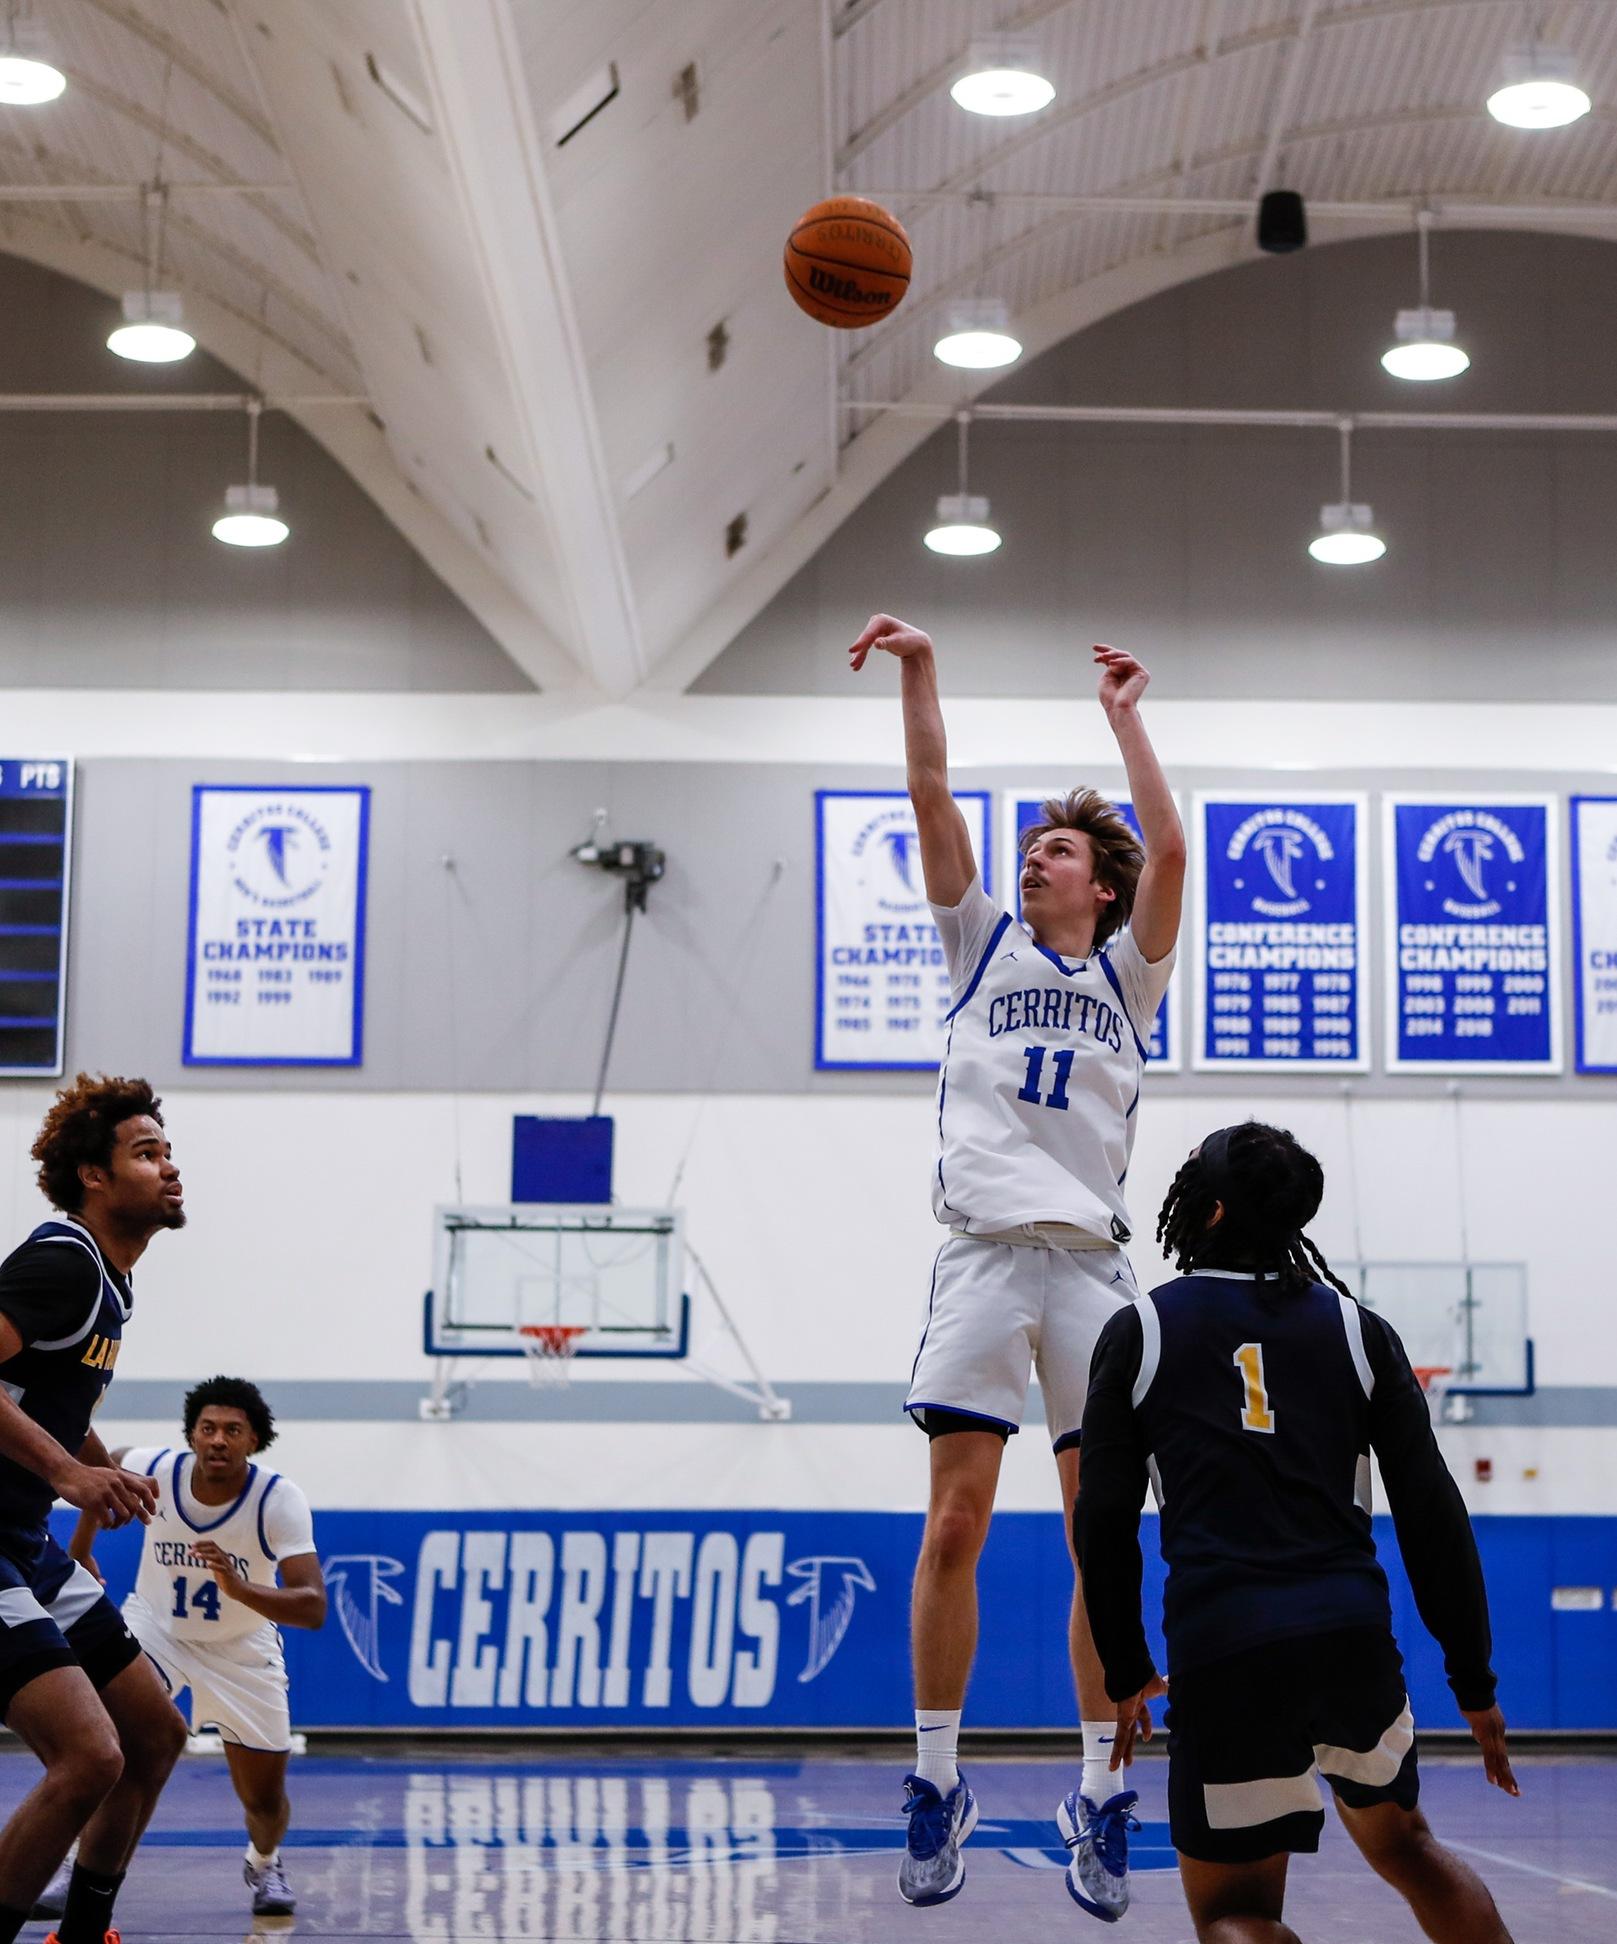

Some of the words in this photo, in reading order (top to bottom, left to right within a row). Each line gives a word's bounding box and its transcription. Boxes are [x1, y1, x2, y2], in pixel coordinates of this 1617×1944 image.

[808, 265, 892, 304] Wilson
[20, 763, 60, 789] PTS
[237, 918, 317, 937] STATE
[1208, 922, 1354, 944] CONFERENCE
[1400, 924, 1545, 946] CONFERENCE
[203, 941, 348, 961] CHAMPIONS
[832, 947, 944, 966] CHAMPIO
[1208, 946, 1354, 968] CHAMPIONS
[1400, 948, 1546, 970] CHAMPIONS
[988, 988, 1123, 1054] CERRITOS
[1017, 1046, 1075, 1110] 11
[1232, 1342, 1275, 1434] 1
[172, 1576, 222, 1621] 14
[408, 1531, 785, 1708] CERRITOS
